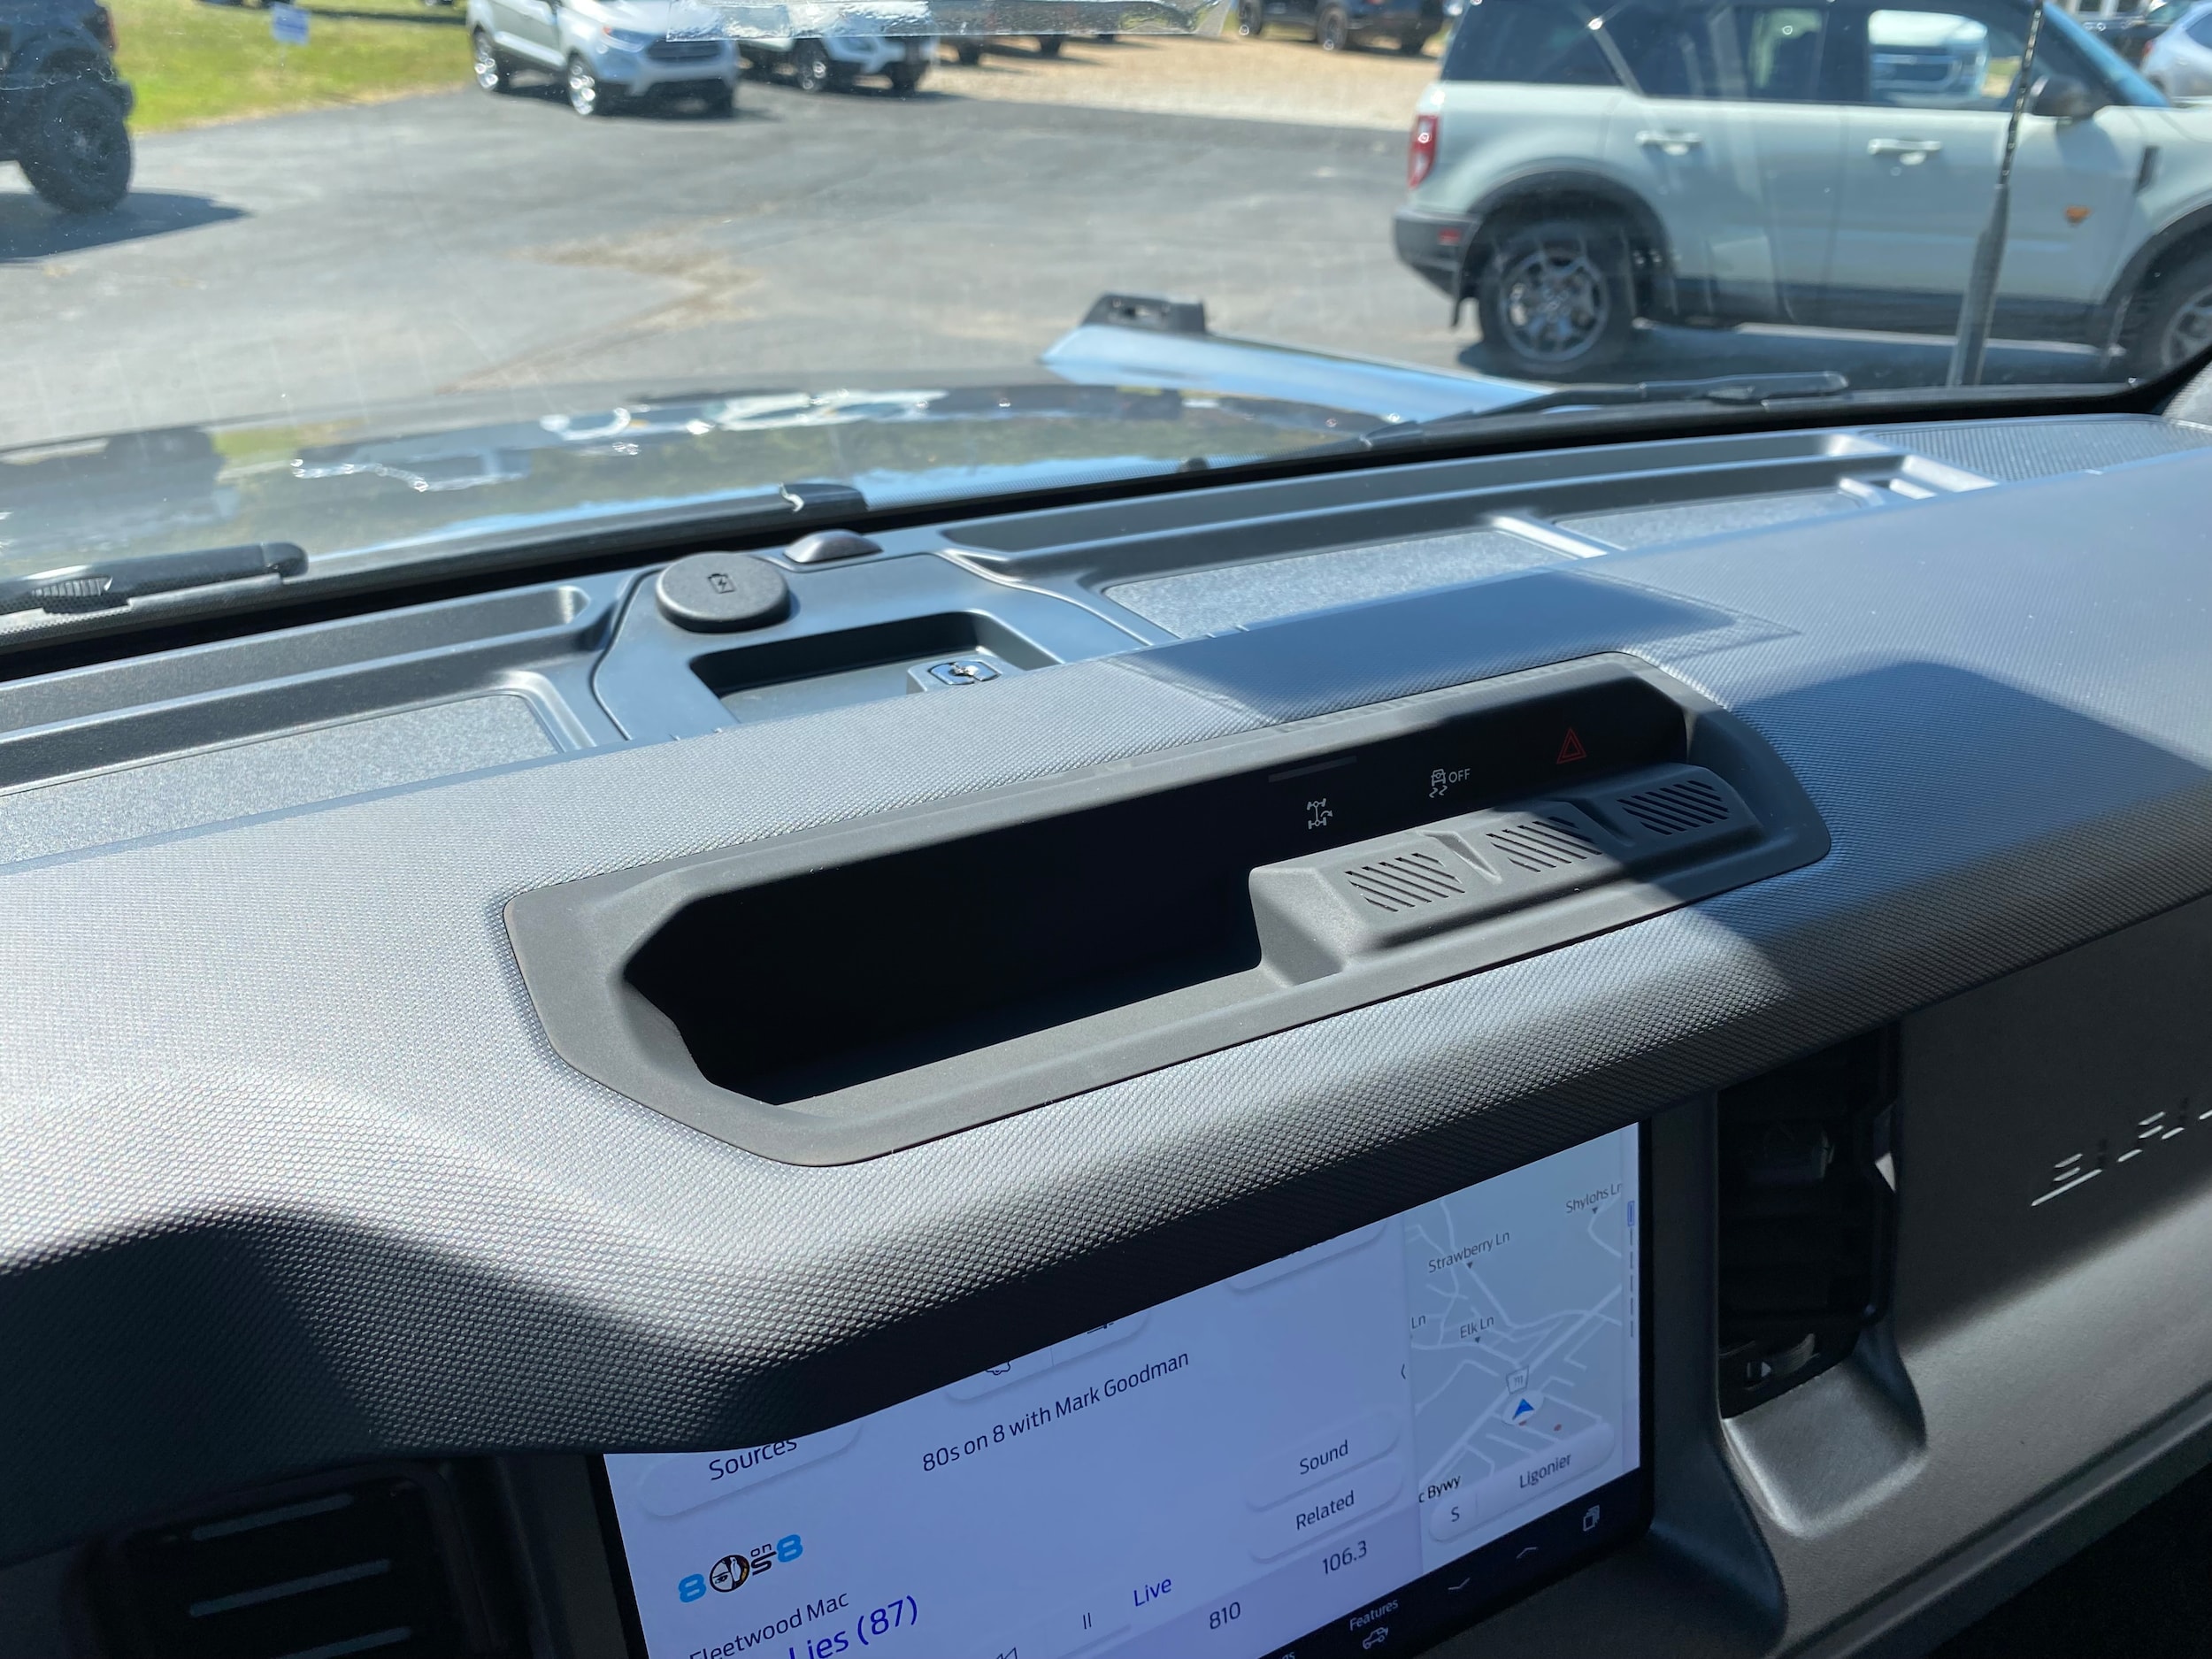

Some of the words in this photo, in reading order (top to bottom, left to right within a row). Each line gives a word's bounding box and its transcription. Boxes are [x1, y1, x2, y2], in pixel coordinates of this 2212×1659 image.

[1448, 768, 1471, 781] OFF
[1565, 1188, 1609, 1214] Shylohs
[1428, 1239, 1494, 1273] Strawberry
[1495, 1232, 1510, 1247] Ln
[1411, 1315, 1426, 1330] Ln
[1460, 1325, 1479, 1339] Elk
[1480, 1316, 1494, 1332] Ln
[923, 1446, 960, 1471] 80s
[964, 1435, 988, 1455] on
[993, 1425, 1005, 1443] 8
[1010, 1407, 1051, 1436] with
[1056, 1386, 1100, 1418] Mark
[1104, 1353, 1189, 1397] Goodman
[709, 1440, 797, 1481] Sources
[1299, 1440, 1349, 1475] Sound
[1519, 1454, 1571, 1489] Ligonier
[1428, 1475, 1462, 1501] Bywy
[1295, 1490, 1355, 1531] Related
[1451, 1507, 1460, 1523] S
[1322, 1540, 1368, 1576] 106.3
[806, 1594, 849, 1622] Mac
[1133, 1578, 1172, 1608] Live
[857, 1595, 918, 1646] (87)
[1209, 1601, 1241, 1630] 810
[1349, 1600, 1399, 1632] Features
